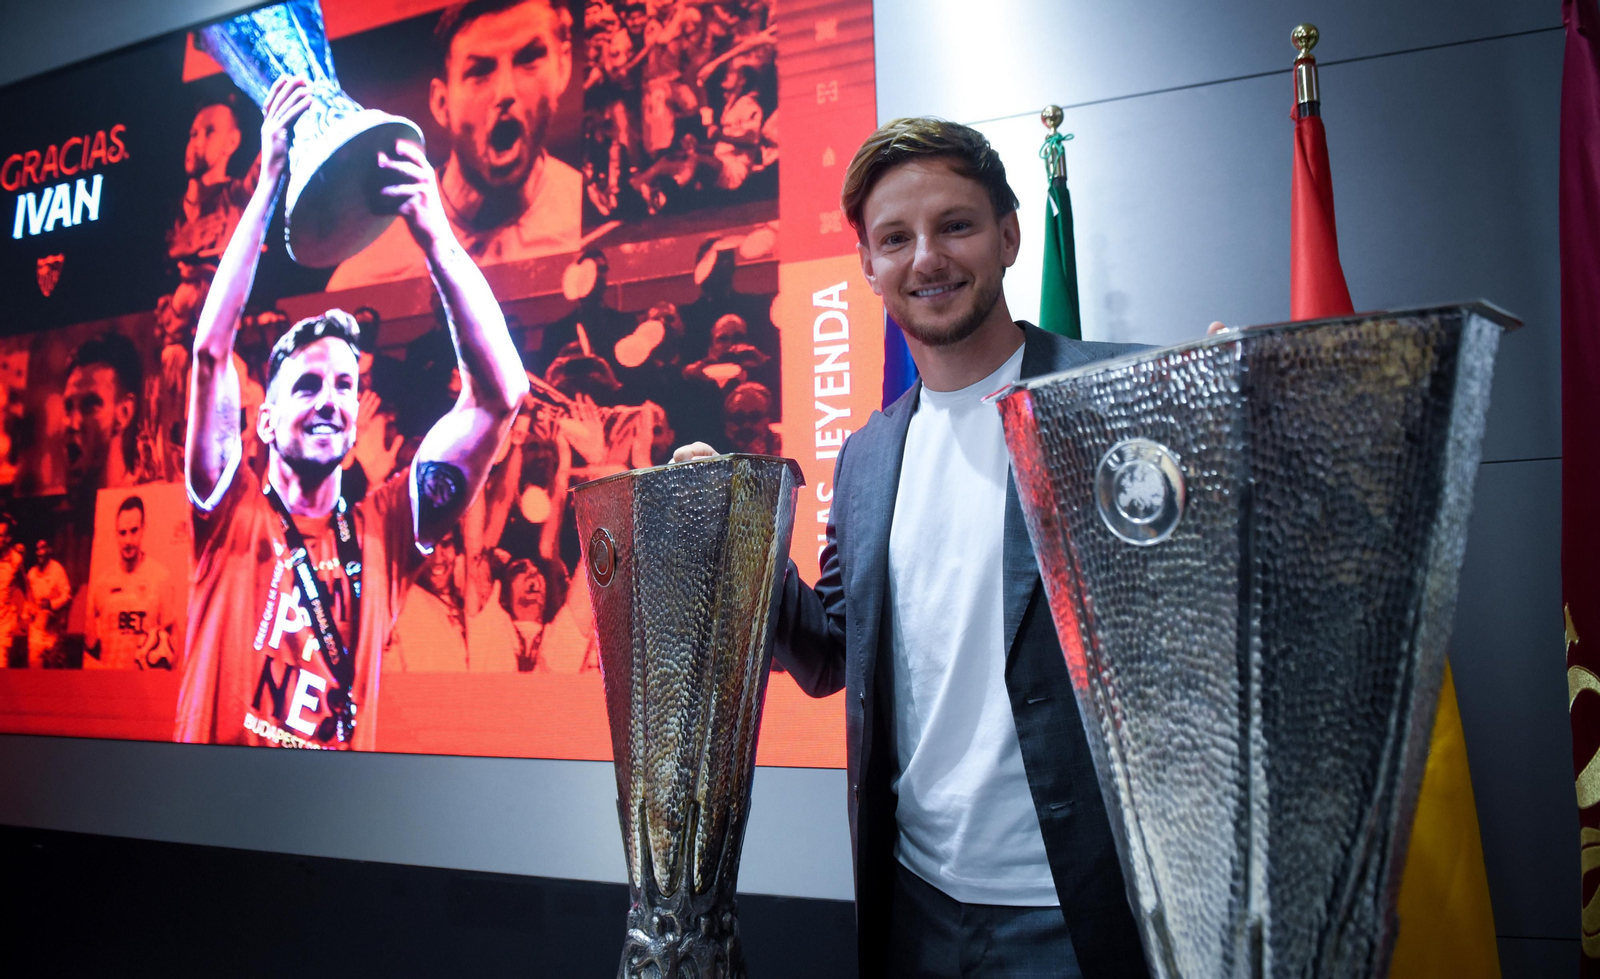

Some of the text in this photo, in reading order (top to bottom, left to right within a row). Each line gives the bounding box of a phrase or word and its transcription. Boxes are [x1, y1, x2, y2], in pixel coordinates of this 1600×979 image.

[0, 123, 131, 192] GRACIAS.
[12, 173, 104, 240] IVAN
[118, 610, 147, 631] BET
